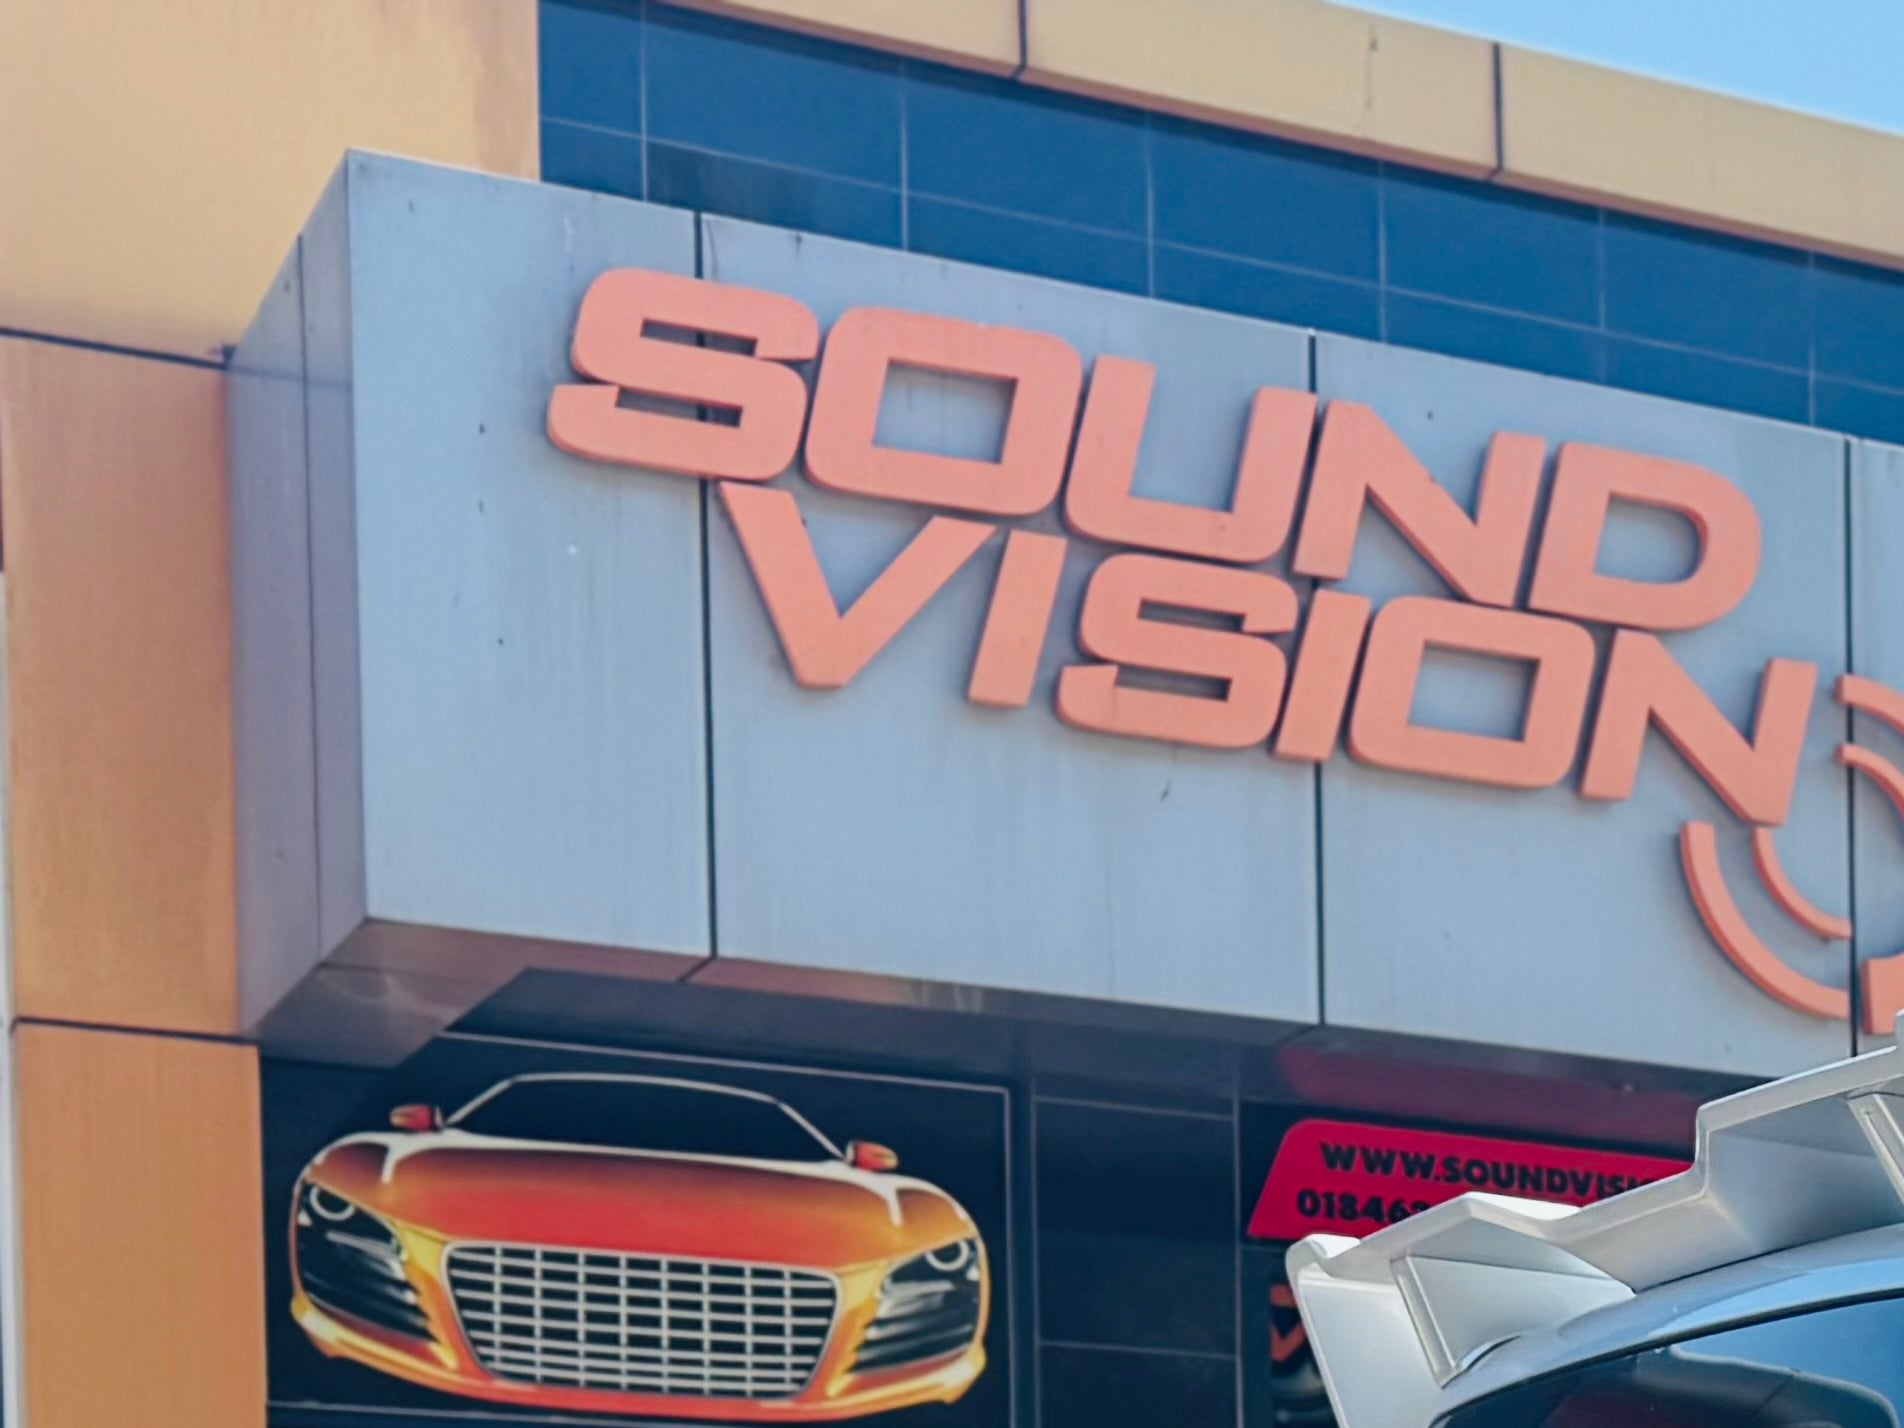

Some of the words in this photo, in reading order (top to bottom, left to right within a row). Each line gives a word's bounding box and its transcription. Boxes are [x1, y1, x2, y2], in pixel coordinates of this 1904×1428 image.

[546, 266, 1763, 632] SOUND
[719, 480, 1817, 827] VISION
[1321, 1142, 1656, 1203] WWW.SOUNDVIS
